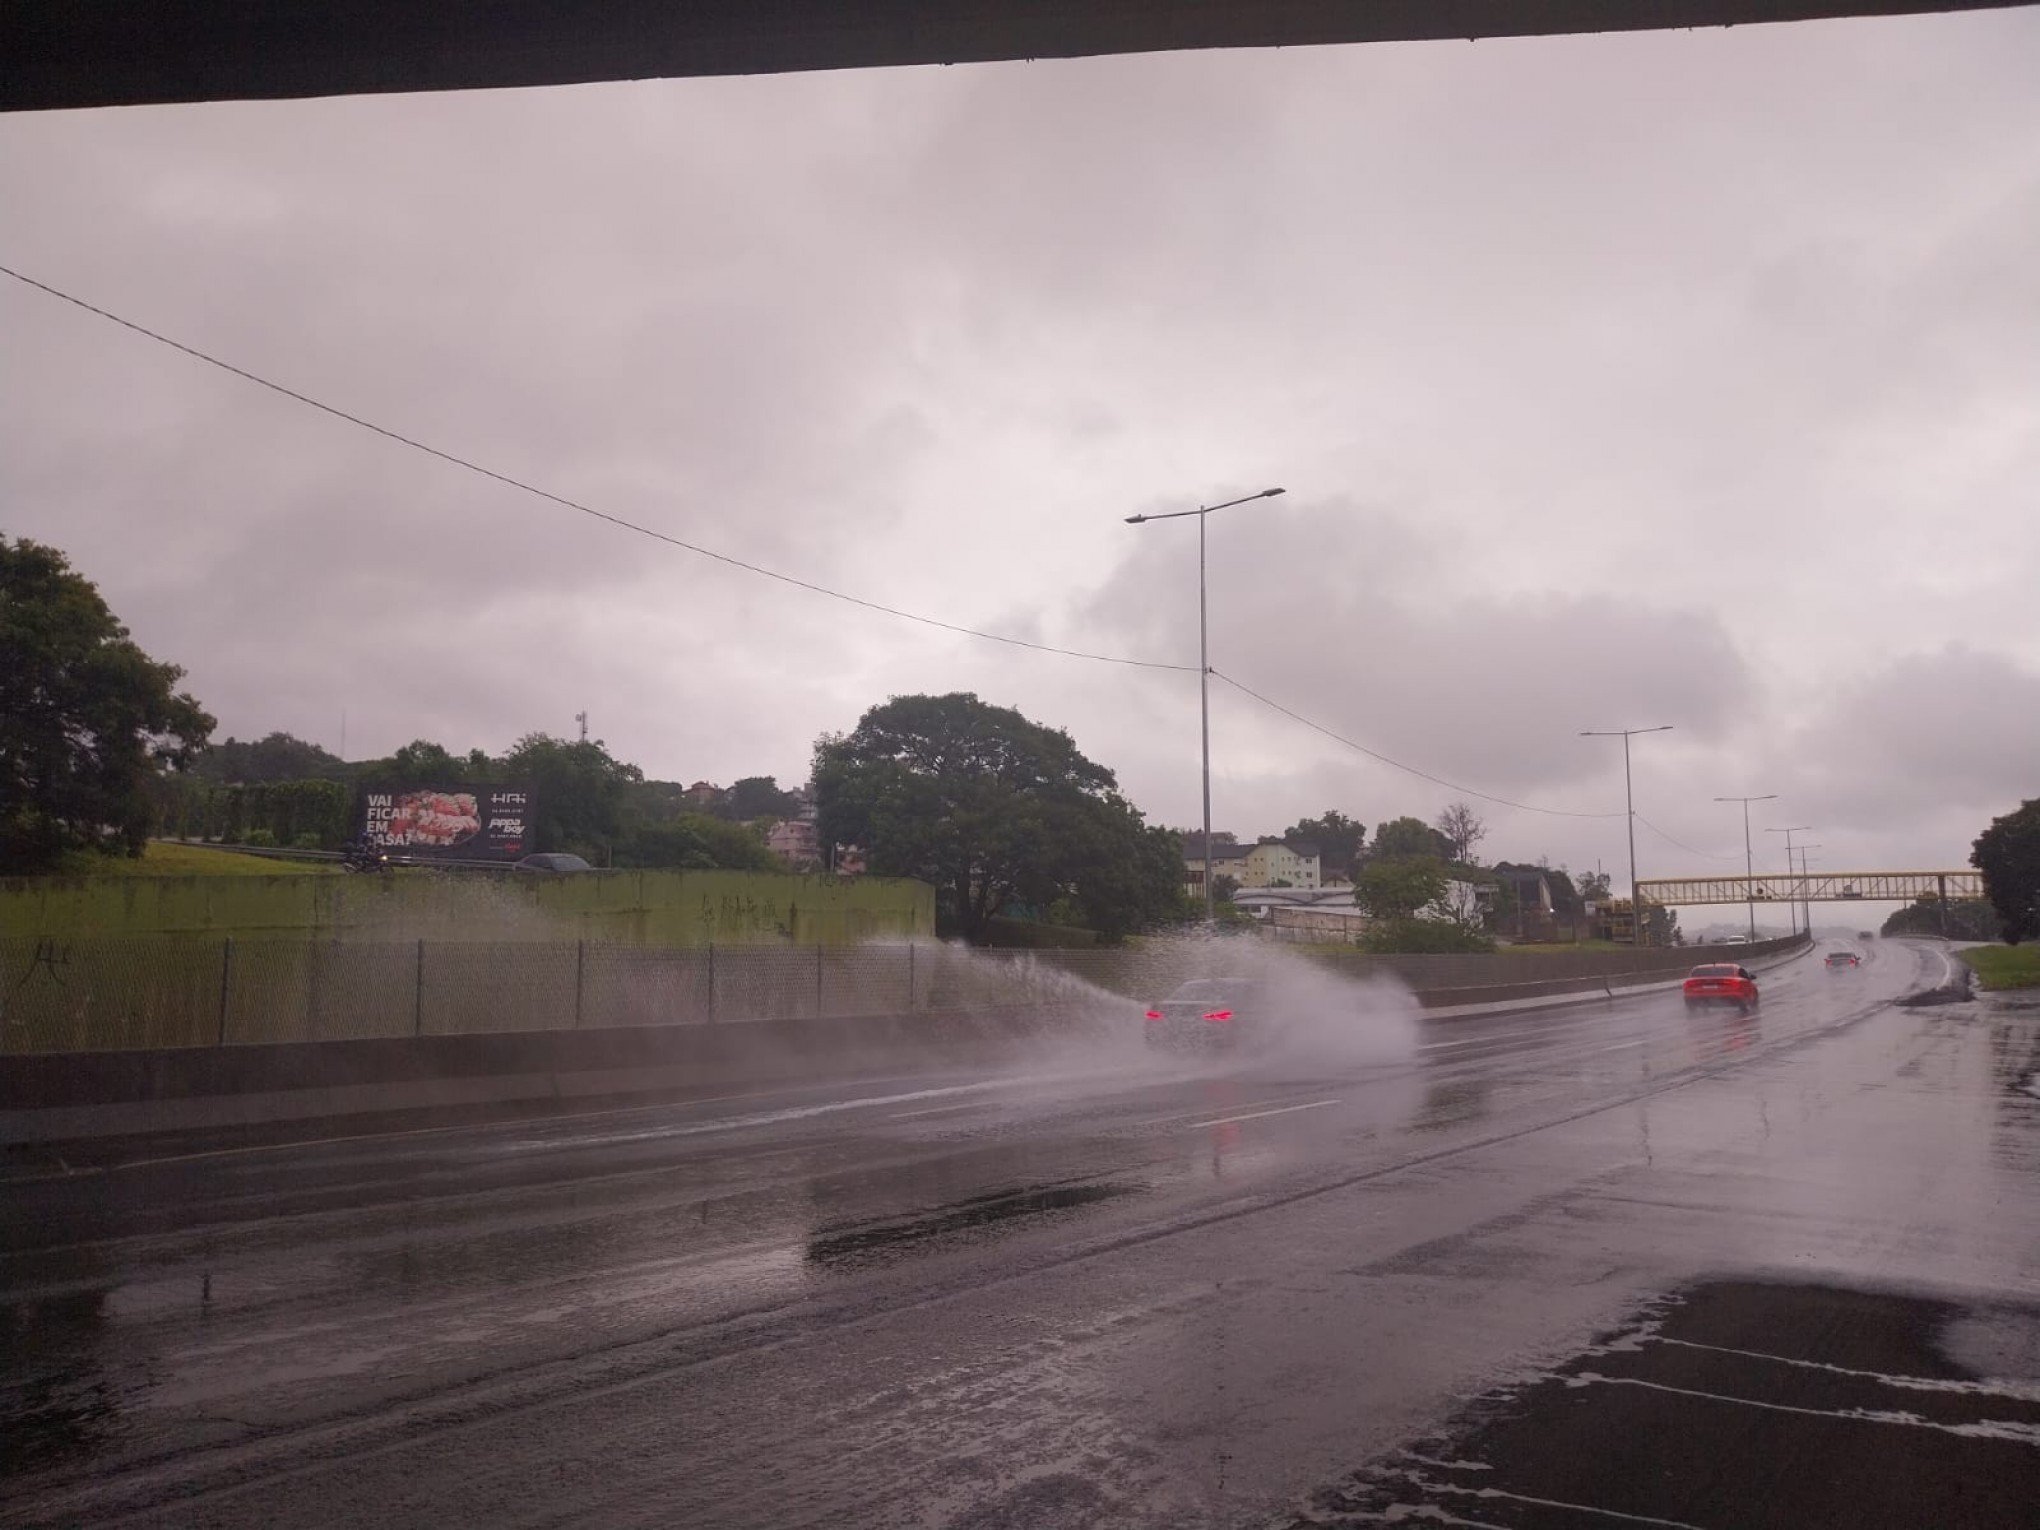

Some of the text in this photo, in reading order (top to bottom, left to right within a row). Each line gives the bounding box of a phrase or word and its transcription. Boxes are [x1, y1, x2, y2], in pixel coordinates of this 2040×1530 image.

[368, 795, 392, 806] VAI
[367, 807, 410, 820] FICAR
[366, 820, 389, 833] EM
